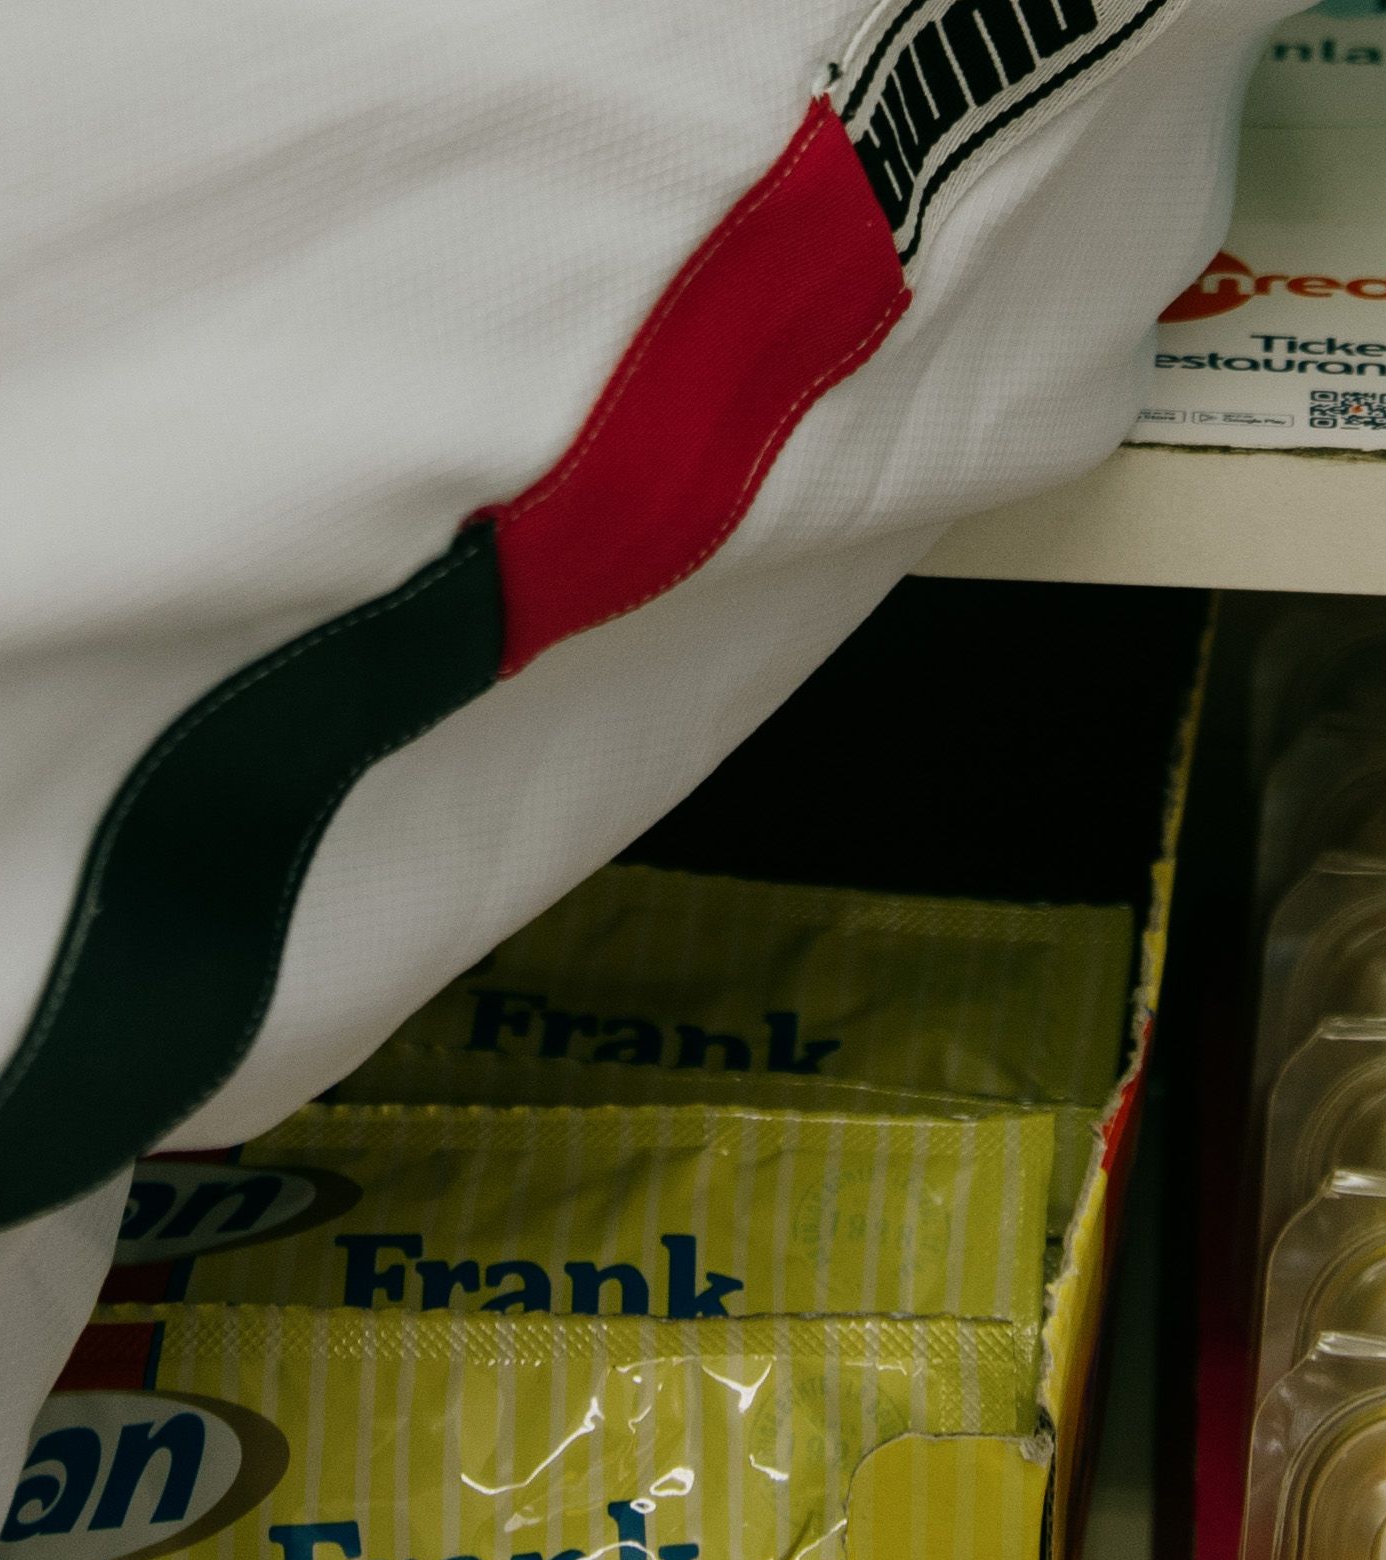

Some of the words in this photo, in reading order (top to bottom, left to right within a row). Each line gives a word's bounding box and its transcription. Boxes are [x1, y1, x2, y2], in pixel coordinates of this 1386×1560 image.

[464, 985, 841, 1075] Frank
[334, 1232, 746, 1321] Frank
[0, 1410, 206, 1543] an
